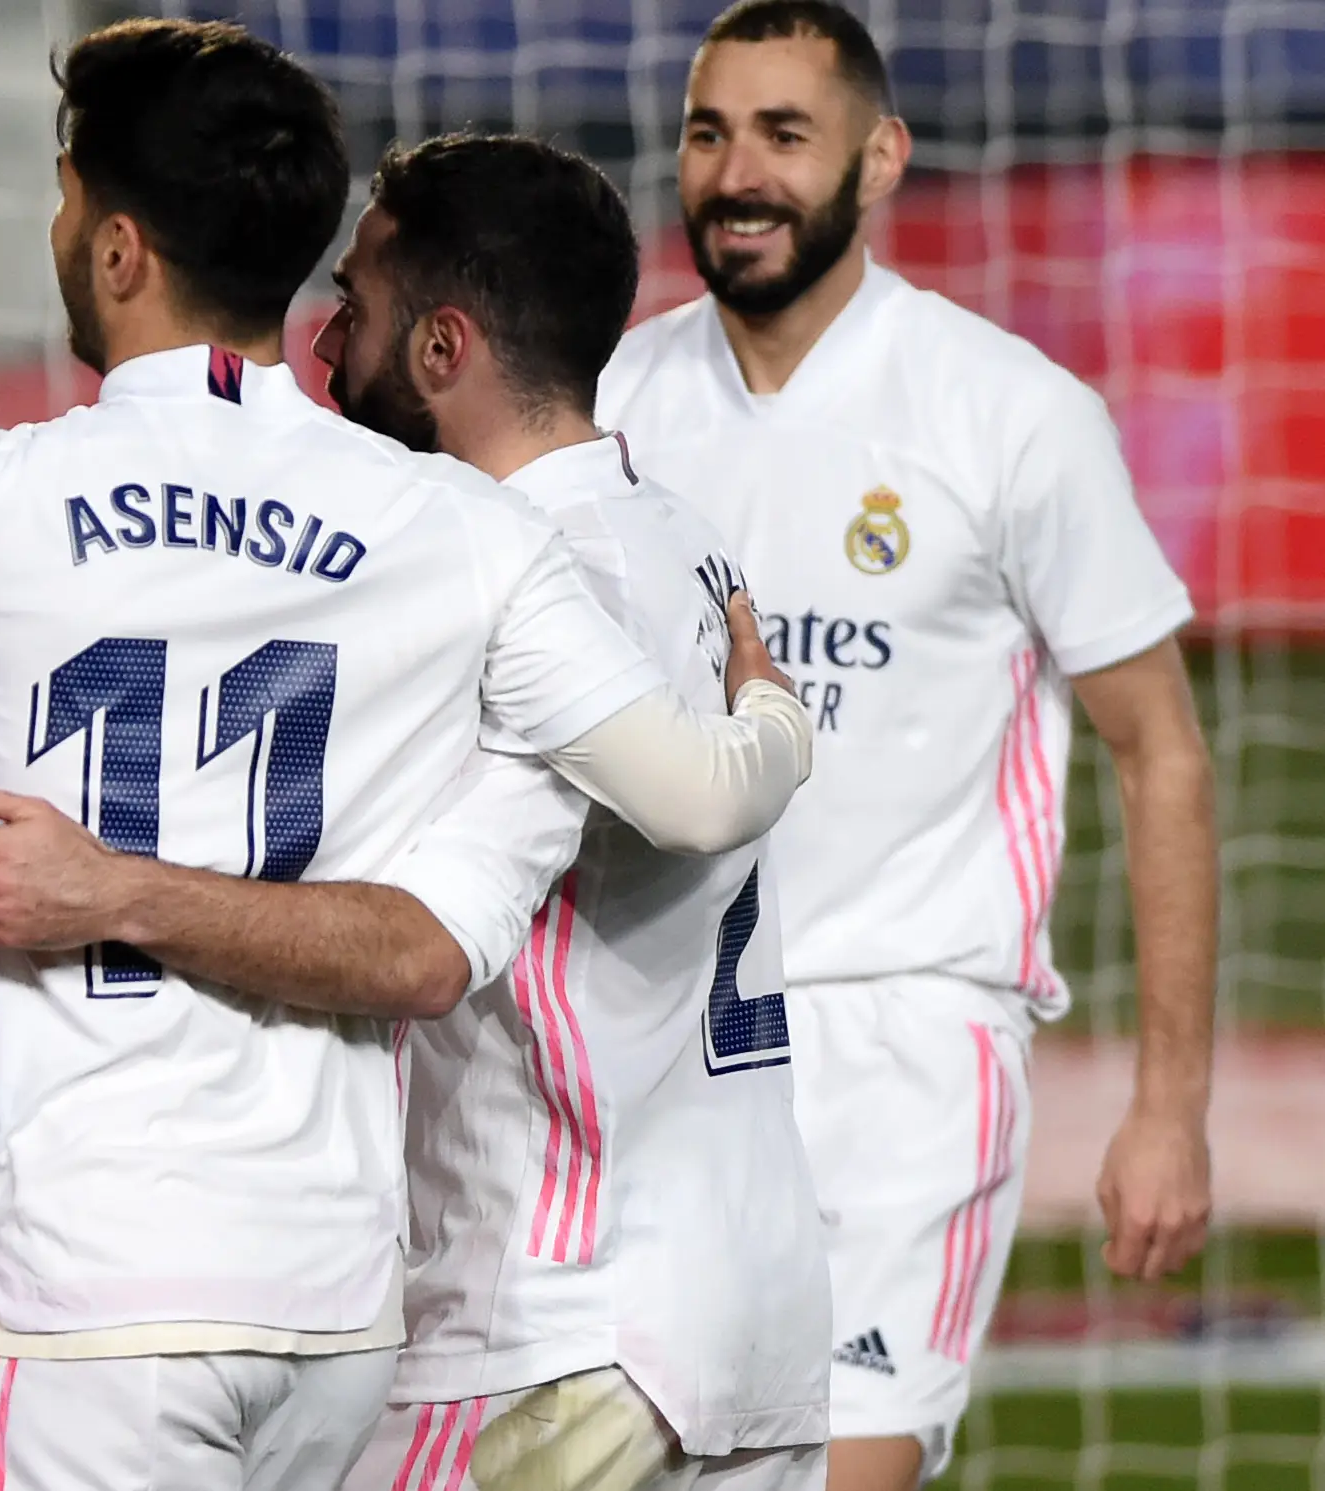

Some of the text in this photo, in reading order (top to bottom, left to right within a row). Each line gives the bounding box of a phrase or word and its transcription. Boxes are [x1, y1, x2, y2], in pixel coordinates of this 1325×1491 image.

[65, 482, 367, 583] ASENSIO
[759, 605, 892, 670] ates
[26, 637, 338, 999] 11
